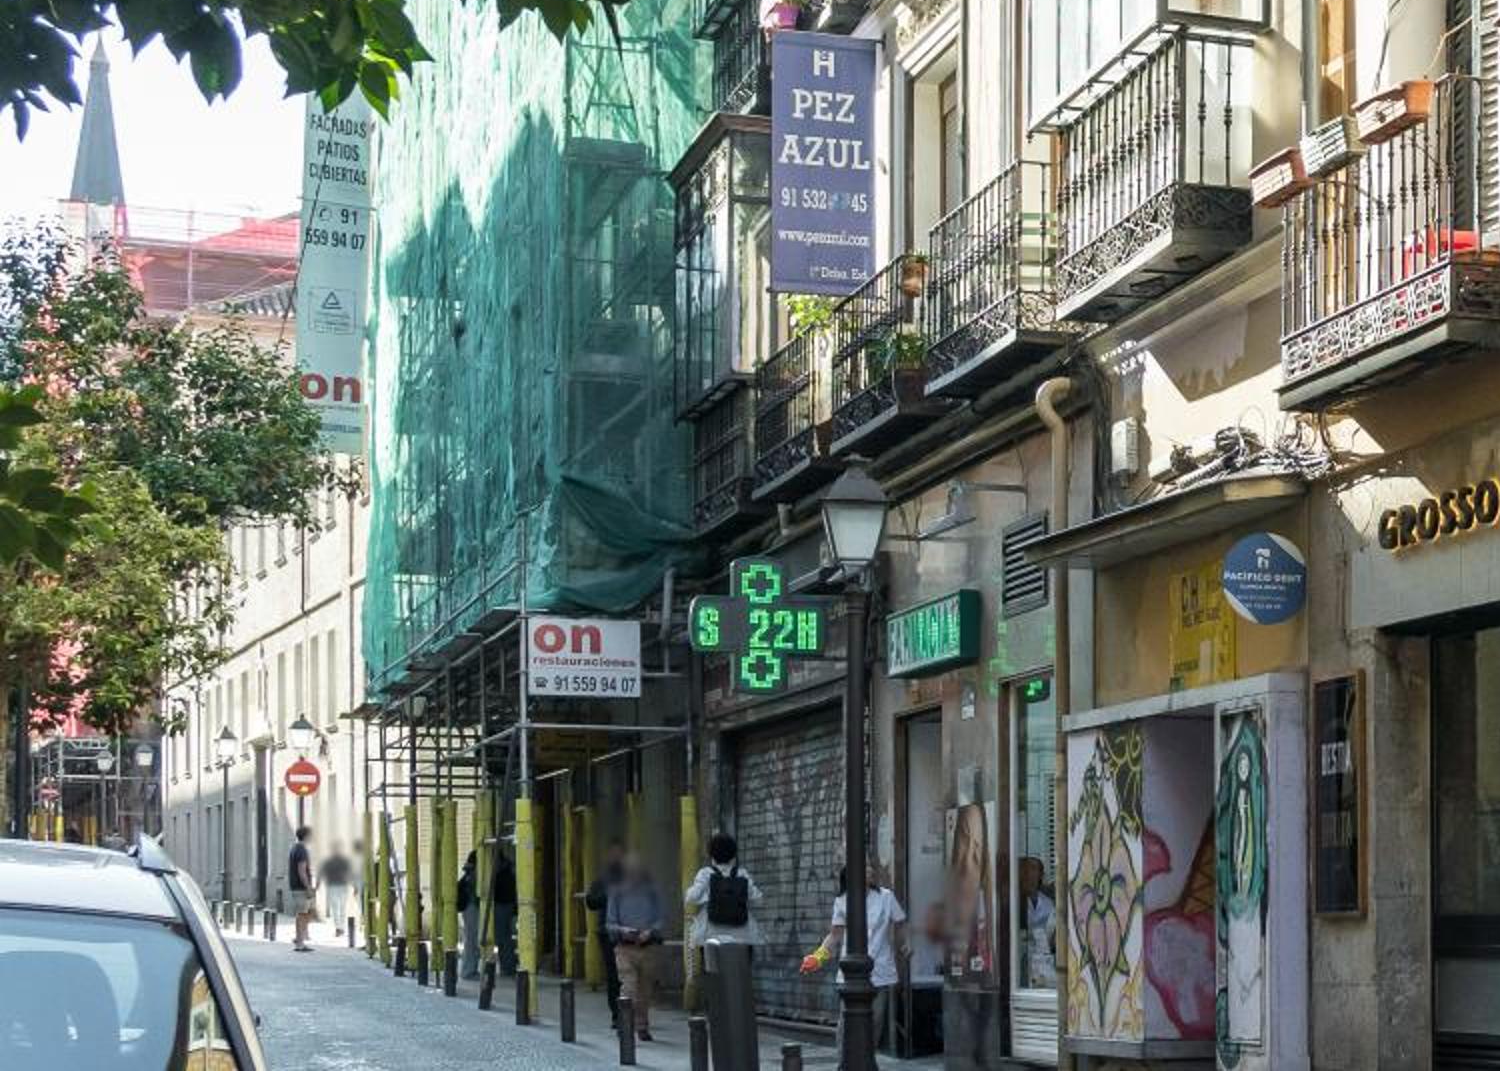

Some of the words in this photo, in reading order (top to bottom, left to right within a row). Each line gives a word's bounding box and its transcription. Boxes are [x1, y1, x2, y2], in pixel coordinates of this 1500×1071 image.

[792, 88, 855, 124] PEZ
[317, 141, 359, 161] PATIOS
[778, 134, 871, 170] AZUL
[781, 187, 797, 207] 91
[802, 188, 827, 210] 532
[851, 193, 867, 212] 45
[341, 209, 358, 225] 91
[331, 229, 347, 248] 94
[351, 233, 366, 250] 07
[300, 372, 361, 403] on
[1377, 479, 1500, 551] GROSSO
[534, 624, 602, 654] on
[749, 609, 817, 649] 22H
[533, 656, 636, 667] restauraciones
[554, 675, 568, 691] 91
[573, 676, 597, 692] 559
[601, 676, 617, 692] 94
[621, 677, 636, 693] 07
